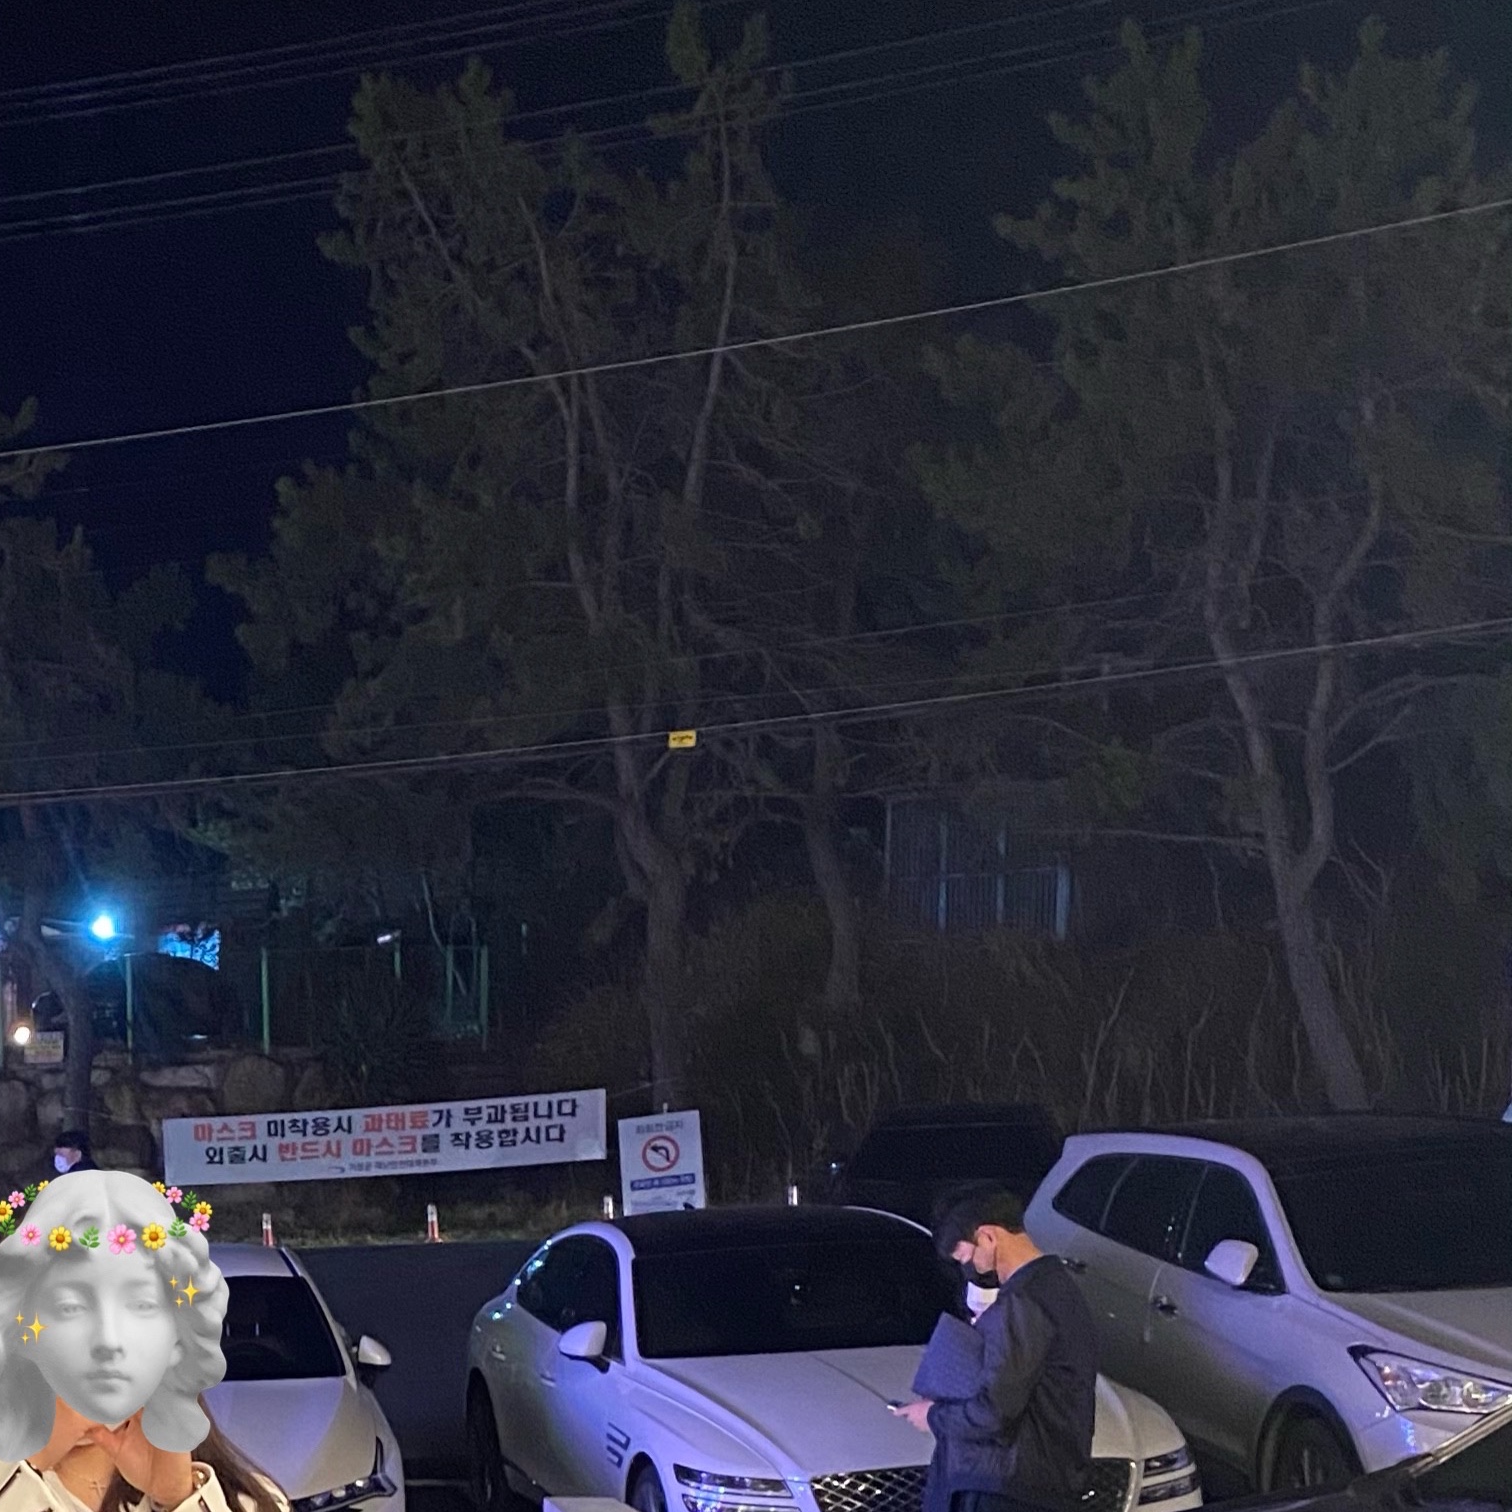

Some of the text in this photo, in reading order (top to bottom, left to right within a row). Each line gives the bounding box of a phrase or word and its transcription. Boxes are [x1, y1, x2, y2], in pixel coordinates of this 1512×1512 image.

[194, 1098, 578, 1142] 마스크 미착용시 과태료가 부과됩니다
[205, 1144, 268, 1165] 외출시
[278, 1140, 342, 1162] 반드시
[351, 1134, 440, 1157] 마스크를
